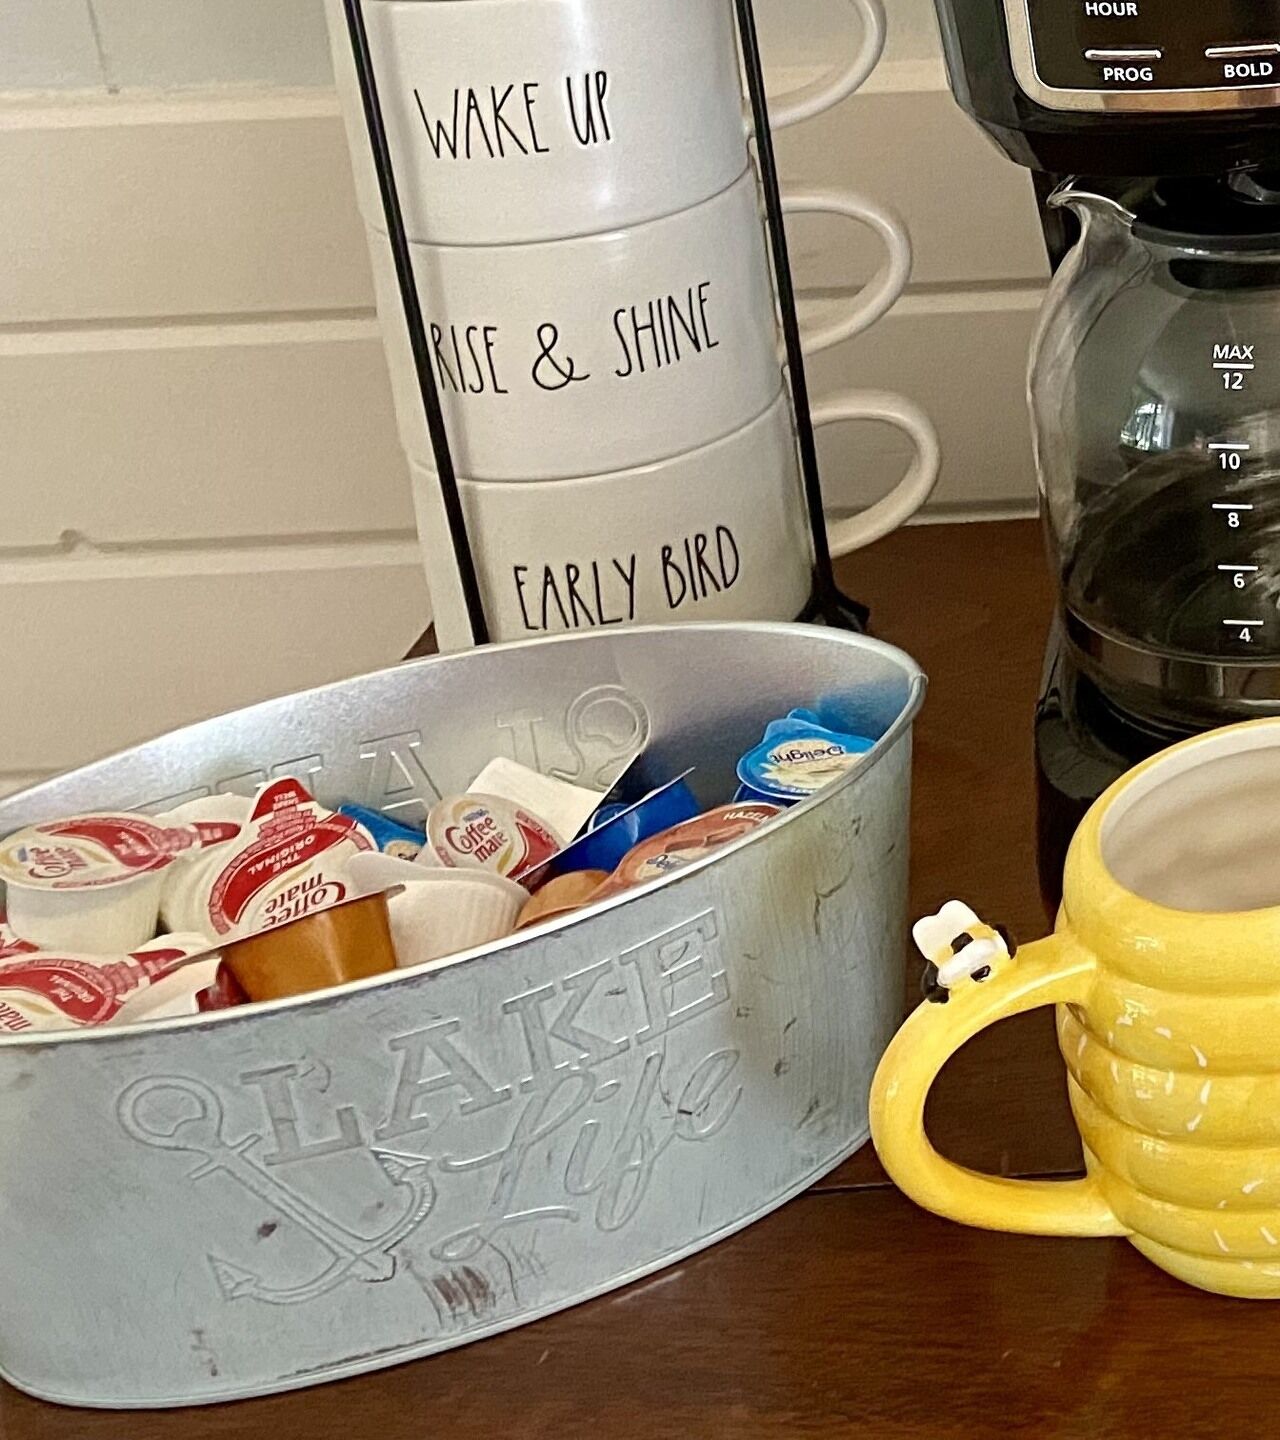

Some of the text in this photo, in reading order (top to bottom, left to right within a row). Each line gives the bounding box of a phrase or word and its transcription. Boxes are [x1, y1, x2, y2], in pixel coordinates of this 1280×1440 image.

[1085, 1, 1138, 17] HOUR
[1103, 67, 1153, 83] PROG
[1224, 62, 1273, 79] BOLD
[413, 69, 613, 161] WAKE UP
[430, 281, 720, 398] RISE & SHINE
[1212, 344, 1255, 360] MAX
[1222, 373, 1244, 390] 12
[1218, 453, 1241, 470] 10
[1228, 512, 1240, 528] 8
[514, 525, 740, 631] EARLY BIRD
[1233, 573, 1246, 588] 6
[1239, 628, 1251, 643] 4
[768, 744, 845, 764] Delight
[445, 817, 497, 854] Coffee
[248, 833, 317, 875] ORIGINAL
[474, 831, 510, 863] mate
[272, 852, 302, 873] THE
[265, 872, 323, 914] mate
[240, 908, 736, 1167] LAKE
